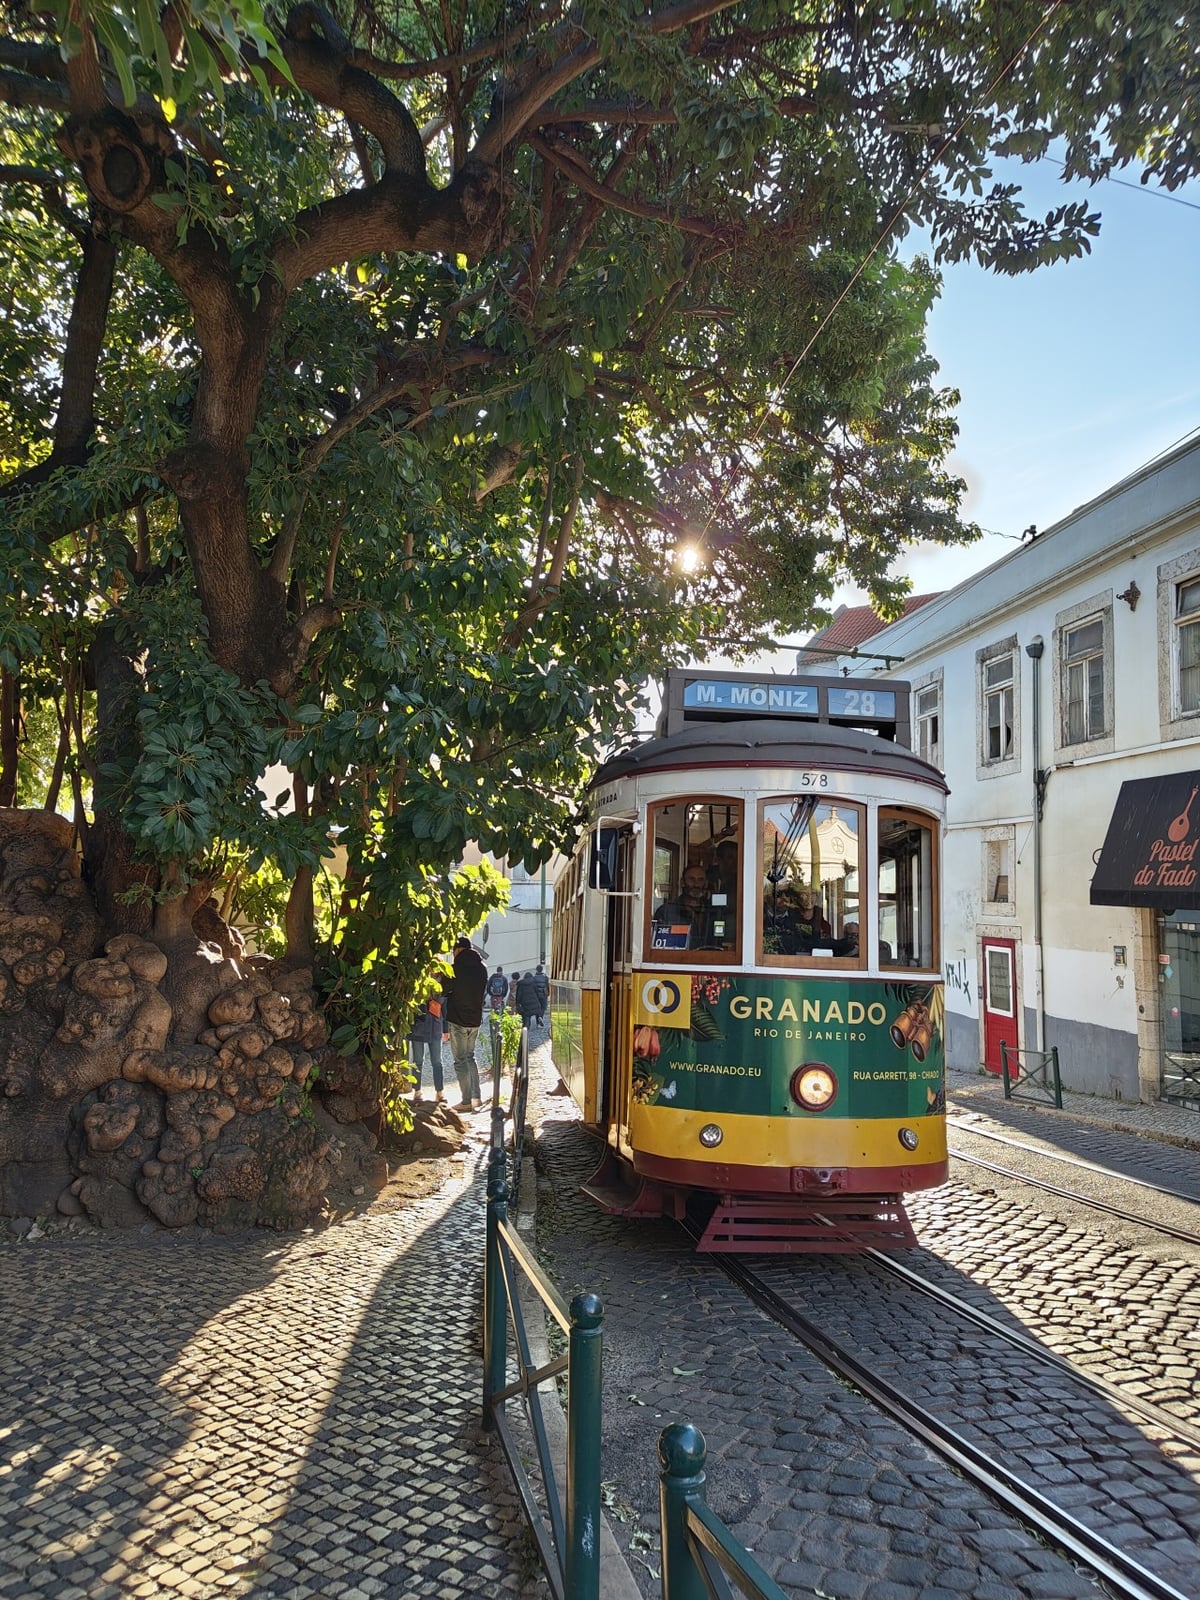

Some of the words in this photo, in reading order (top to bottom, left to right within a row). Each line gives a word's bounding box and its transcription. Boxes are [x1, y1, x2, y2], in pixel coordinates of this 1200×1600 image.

[697, 685, 723, 703] M.
[731, 688, 809, 708] MONIZ
[844, 691, 876, 716] 28
[801, 773, 828, 787] 578
[1149, 839, 1200, 862] Pastel
[1134, 865, 1155, 885] do
[1156, 863, 1197, 886] Fado
[729, 995, 887, 1026] GRANADO
[754, 1028, 779, 1038] RIO
[785, 1029, 802, 1039] DE
[807, 1031, 867, 1041] JANEIRO
[669, 1060, 761, 1077] WWW.GRANADO.EU
[853, 1071, 872, 1080] RUA
[909, 1071, 917, 1080] 98
[921, 1070, 940, 1080] CHIADO
